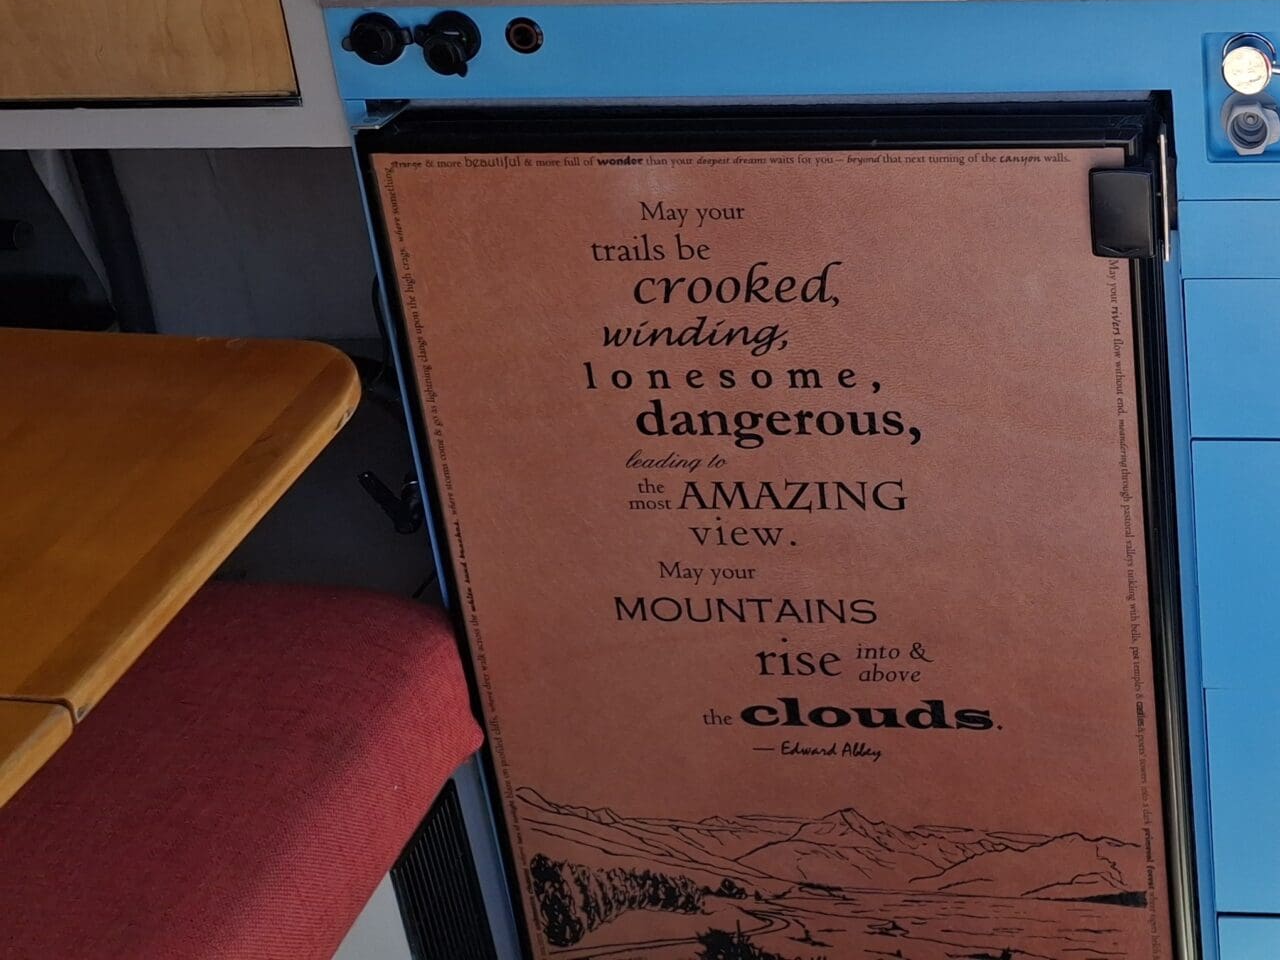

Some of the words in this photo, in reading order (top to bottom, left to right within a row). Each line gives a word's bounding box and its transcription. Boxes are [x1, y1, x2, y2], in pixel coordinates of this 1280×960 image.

[437, 160, 462, 168] more
[464, 156, 521, 170] beautiful
[564, 156, 580, 166] full
[583, 156, 595, 166] of
[597, 156, 644, 166] wonder
[646, 155, 668, 166] than
[671, 158, 692, 168] your
[696, 155, 730, 168] deepest
[770, 154, 794, 164] waits
[798, 153, 812, 164] for
[847, 154, 882, 166] beyond
[882, 153, 902, 164] that
[905, 154, 924, 164] next
[929, 153, 964, 166] turning
[968, 152, 980, 162] of
[982, 152, 997, 163] the
[1000, 154, 1041, 166] canyon
[384, 167, 398, 216] something
[640, 201, 688, 228] May
[696, 206, 745, 228] your
[394, 216, 404, 242] where
[591, 234, 666, 263] trails
[677, 234, 711, 262] be
[402, 272, 416, 293] high
[1106, 260, 1119, 280] May
[633, 261, 842, 308] crooked,
[1106, 281, 1119, 304] your
[407, 294, 416, 309] the
[410, 311, 424, 334] upon
[1112, 306, 1122, 335] rivers
[418, 336, 428, 362] clangs
[602, 316, 789, 357] winding,
[1113, 336, 1124, 359] flow
[424, 364, 438, 403] lightning
[1114, 360, 1126, 395] without
[431, 405, 438, 414] as
[432, 416, 444, 428] go
[635, 399, 922, 450] dangerous,
[438, 438, 447, 461] come
[1118, 418, 1129, 468] meandering
[625, 450, 702, 473] leading
[708, 454, 728, 470] to
[638, 479, 666, 496] the
[677, 478, 908, 514] AMAZING
[1120, 468, 1133, 503] through
[448, 491, 457, 516] where
[629, 495, 672, 511] most
[688, 516, 798, 546] view.
[1120, 504, 1135, 538] pastoral
[1126, 540, 1136, 567] valleys
[658, 561, 702, 584] May
[710, 566, 756, 585] your
[1126, 569, 1139, 602] tinkling
[470, 614, 480, 626] the
[614, 596, 878, 624] MOUNTAINS
[1129, 602, 1140, 622] with
[755, 637, 843, 678] rise
[856, 643, 901, 660] into
[908, 642, 936, 662] &
[1129, 646, 1139, 661] past
[858, 665, 922, 684] above
[1131, 661, 1144, 692] temples
[702, 709, 733, 727] the
[740, 697, 1004, 730] clouds.
[842, 741, 882, 761] Abbey
